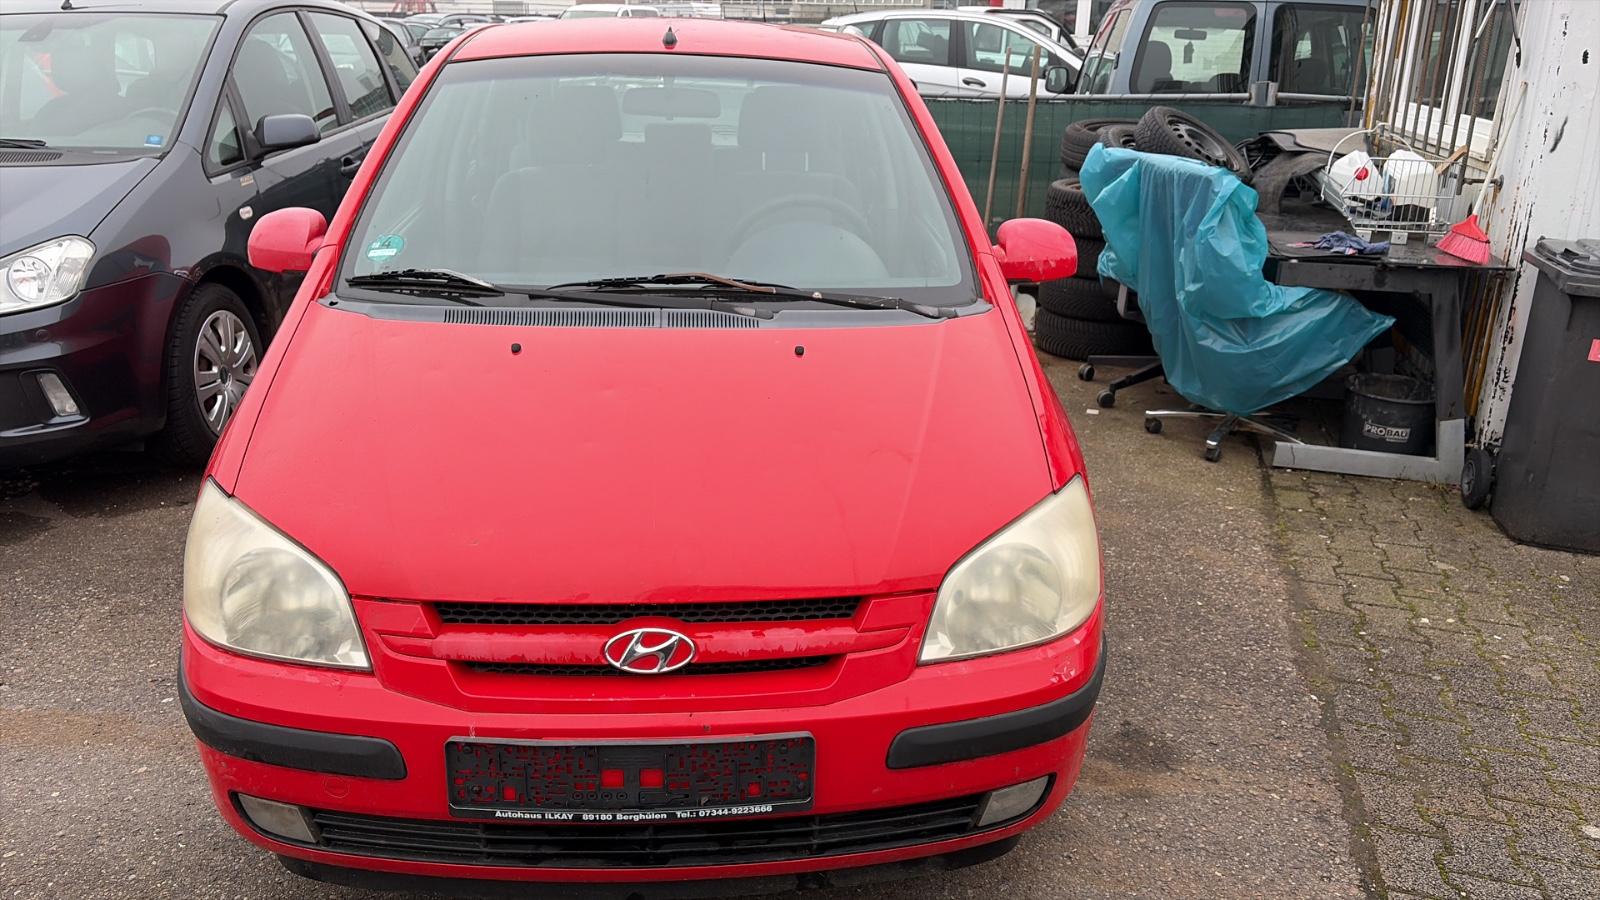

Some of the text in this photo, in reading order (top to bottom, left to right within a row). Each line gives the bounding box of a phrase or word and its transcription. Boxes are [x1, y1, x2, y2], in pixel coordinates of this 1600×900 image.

[381, 236, 392, 248] 4
[1365, 424, 1408, 438] PROBAU
[495, 810, 542, 820] Autohaus
[545, 812, 574, 820] ILKAY
[616, 812, 667, 822] Berghülen
